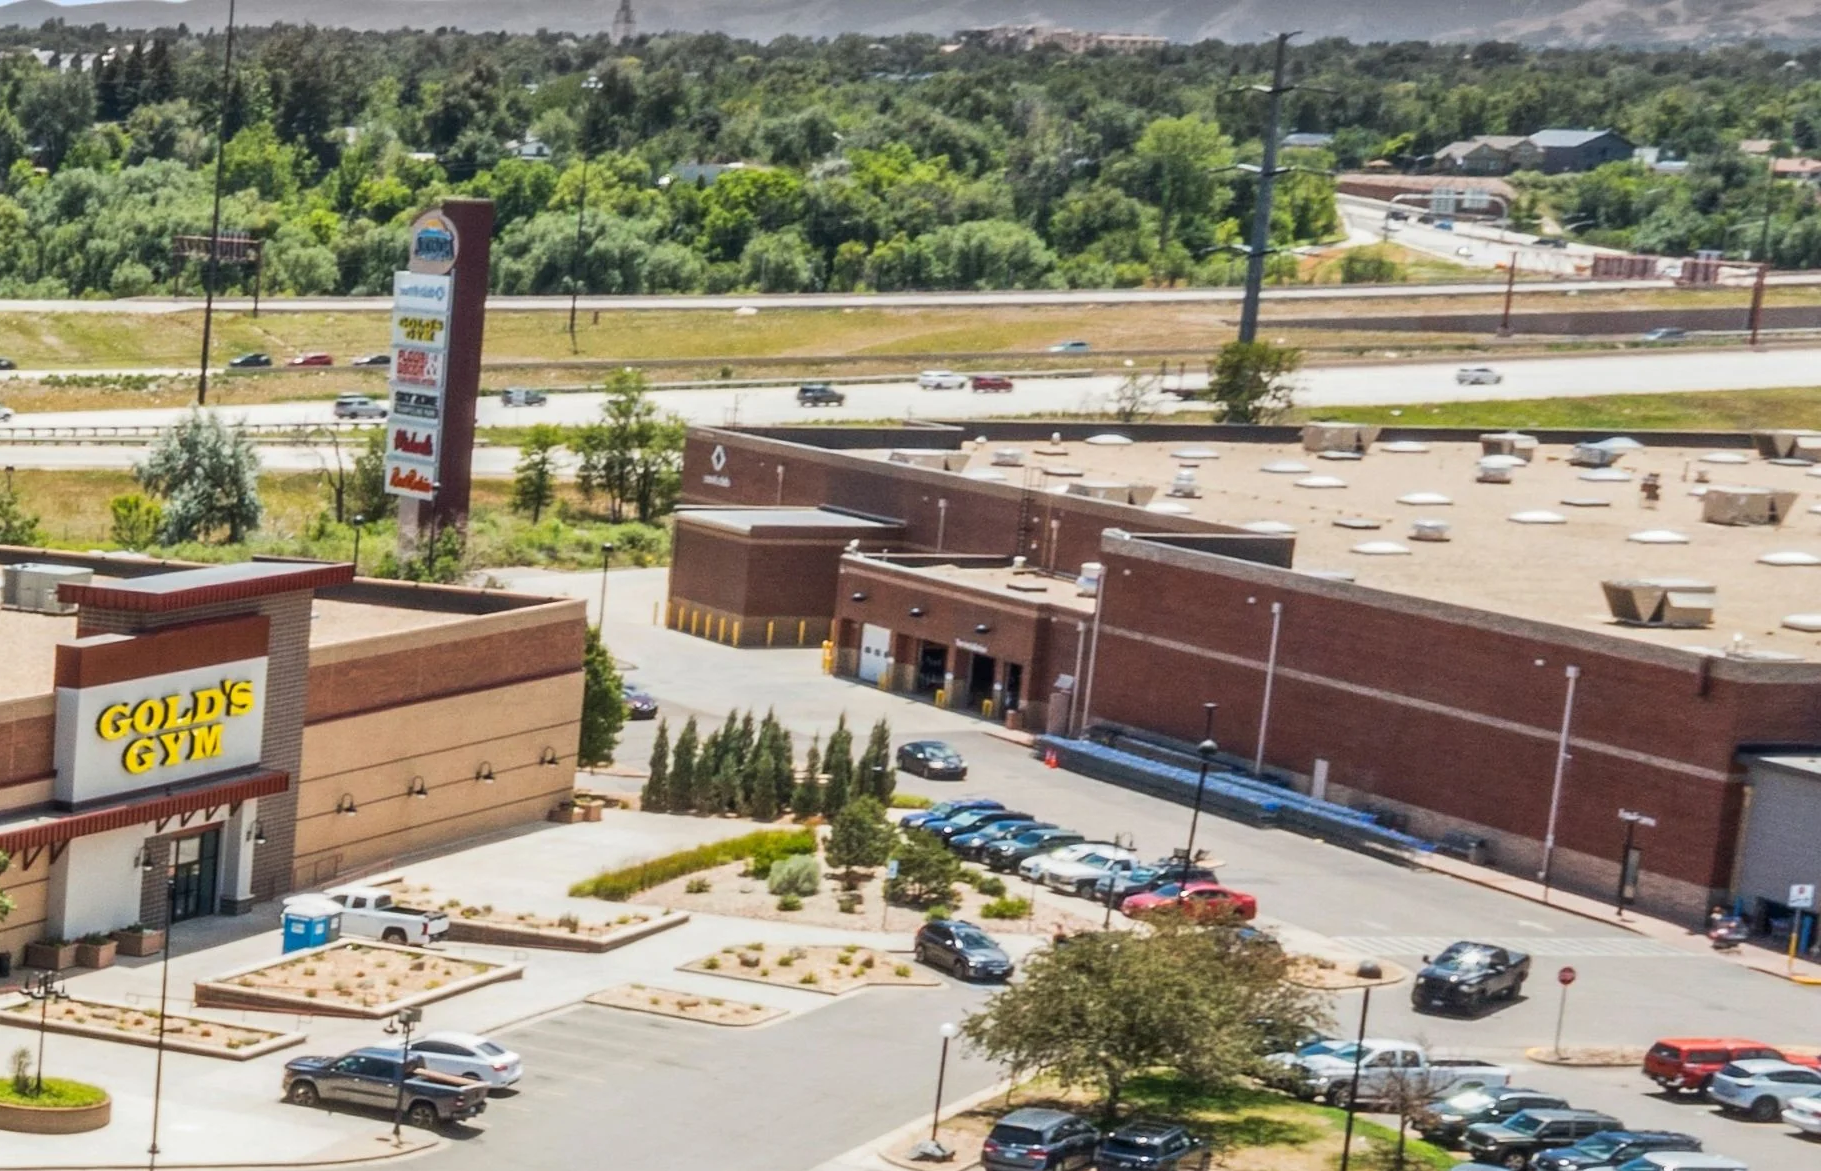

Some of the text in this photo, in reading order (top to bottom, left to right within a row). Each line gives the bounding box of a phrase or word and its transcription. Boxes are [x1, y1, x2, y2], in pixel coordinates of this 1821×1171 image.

[399, 316, 444, 332] GOLD'S
[405, 329, 435, 342] GYM
[96, 679, 255, 742] GOLD'S
[122, 723, 224, 775] GYM
